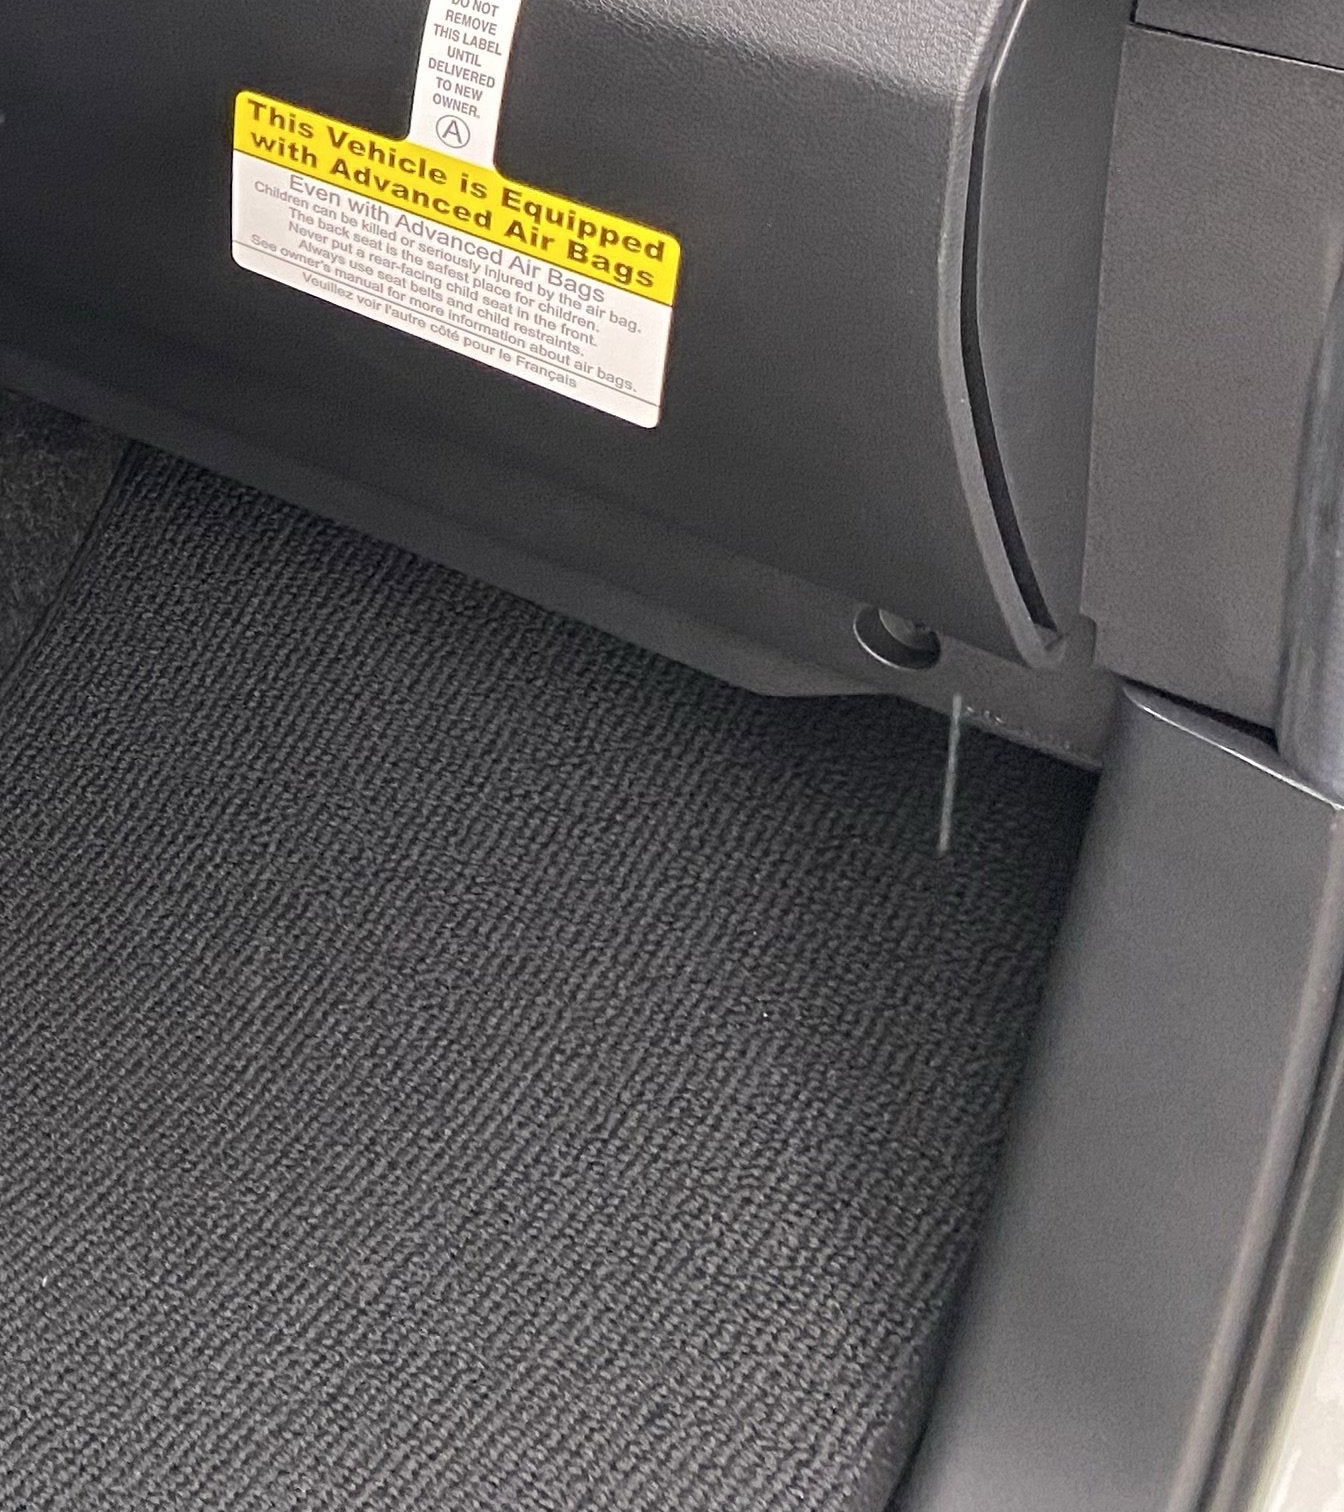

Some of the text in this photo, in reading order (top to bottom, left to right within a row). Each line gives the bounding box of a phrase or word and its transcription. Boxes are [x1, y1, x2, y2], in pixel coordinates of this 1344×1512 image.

[434, 24, 502, 55] THIS LABEL
[445, 9, 497, 36] REMOVE
[447, 46, 481, 67] UNTIL
[472, 0, 499, 17] NOT
[429, 57, 495, 88] DELIVERED
[433, 93, 480, 119] OWNER.
[436, 77, 483, 101] TO NEW
[248, 98, 665, 262] This Vehicle is Equipped
[251, 131, 654, 288] with Advanced Air Bags
[254, 181, 641, 333] Children can be killed or seriously injured by the air bag.
[289, 207, 600, 332] The back seat is the safest place for children.
[289, 221, 326, 244] Never
[332, 239, 352, 254] put
[356, 247, 365, 258] a
[369, 252, 442, 289] rear-facing
[446, 281, 478, 301] child
[483, 295, 513, 314] seat
[517, 308, 529, 320] in
[534, 313, 556, 330] the
[290, 174, 605, 302] Even with Advanced Air Bags
[251, 234, 637, 392] See owner's manual for more information about air bags.
[299, 240, 585, 357] Always use seat belts and child restraints.
[302, 271, 577, 388] Veuillez voir l'autre côté pour le Français
